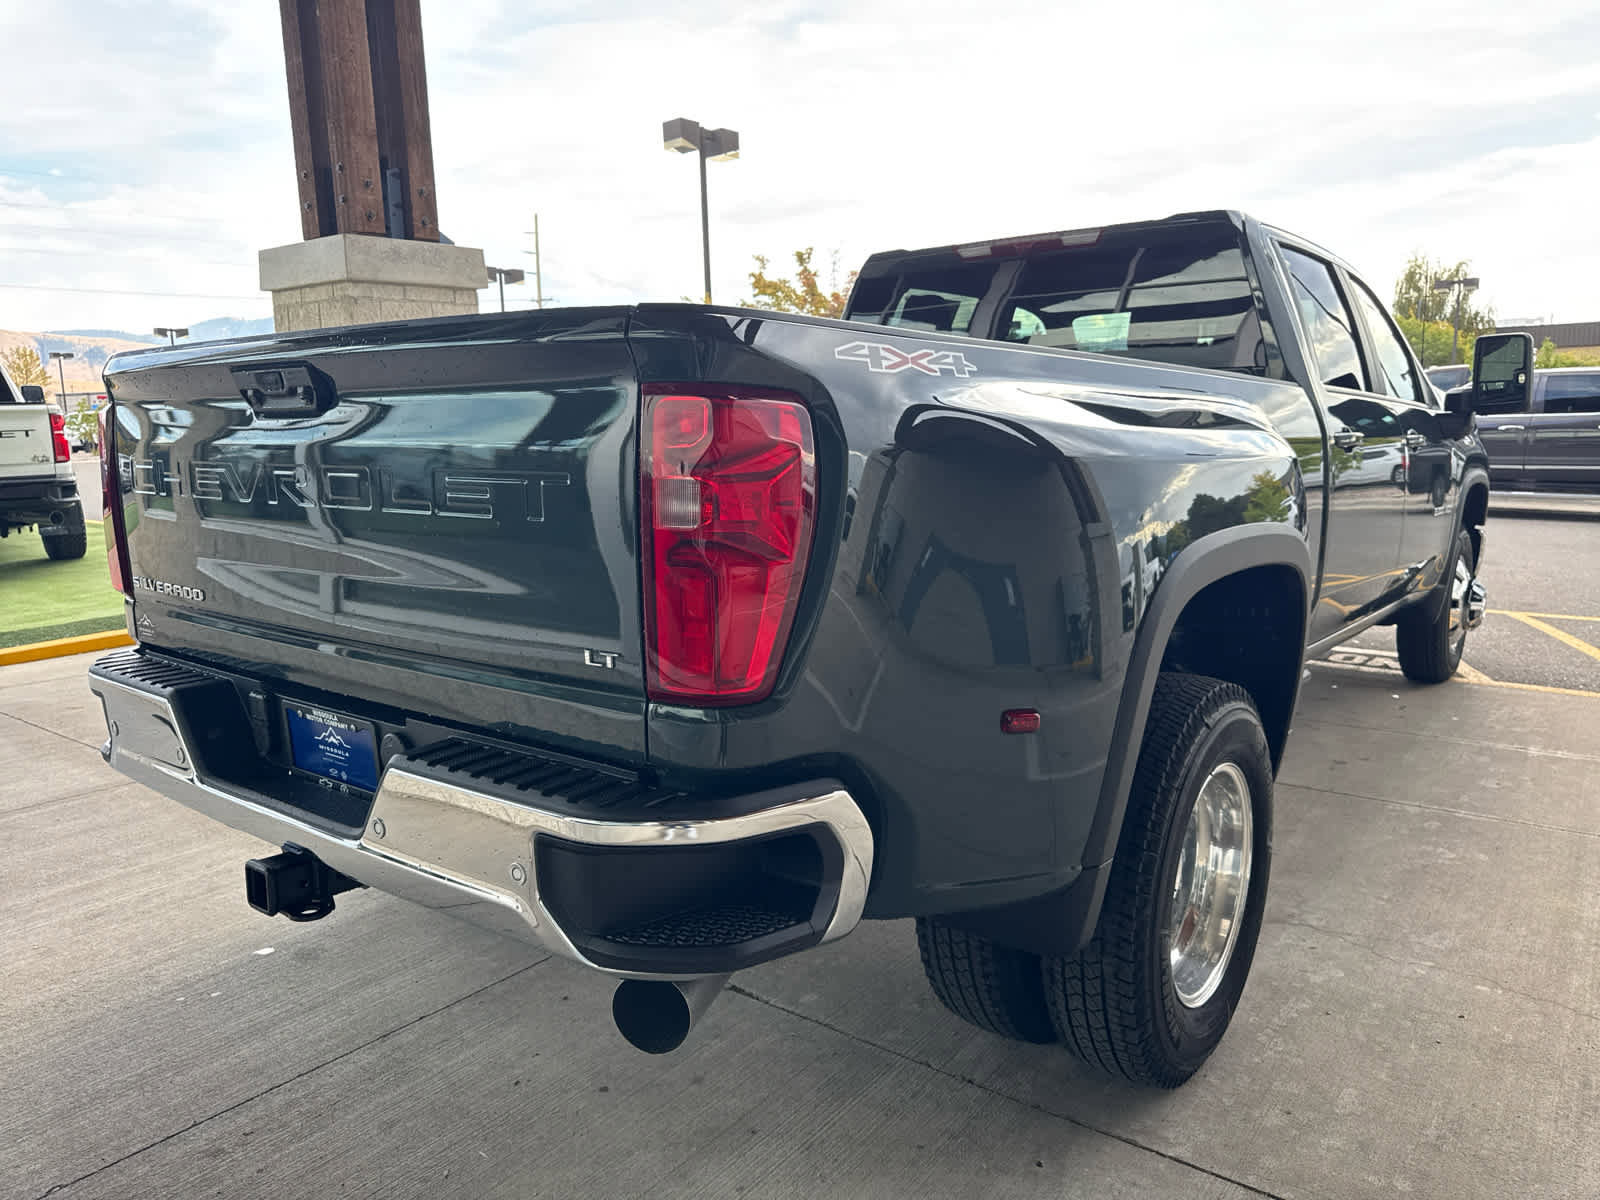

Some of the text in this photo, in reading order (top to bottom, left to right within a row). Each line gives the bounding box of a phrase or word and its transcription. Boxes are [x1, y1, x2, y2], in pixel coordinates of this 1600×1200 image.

[131, 459, 570, 522] CHEVROLET
[132, 576, 205, 601] SILVERADO
[584, 649, 619, 669] LT
